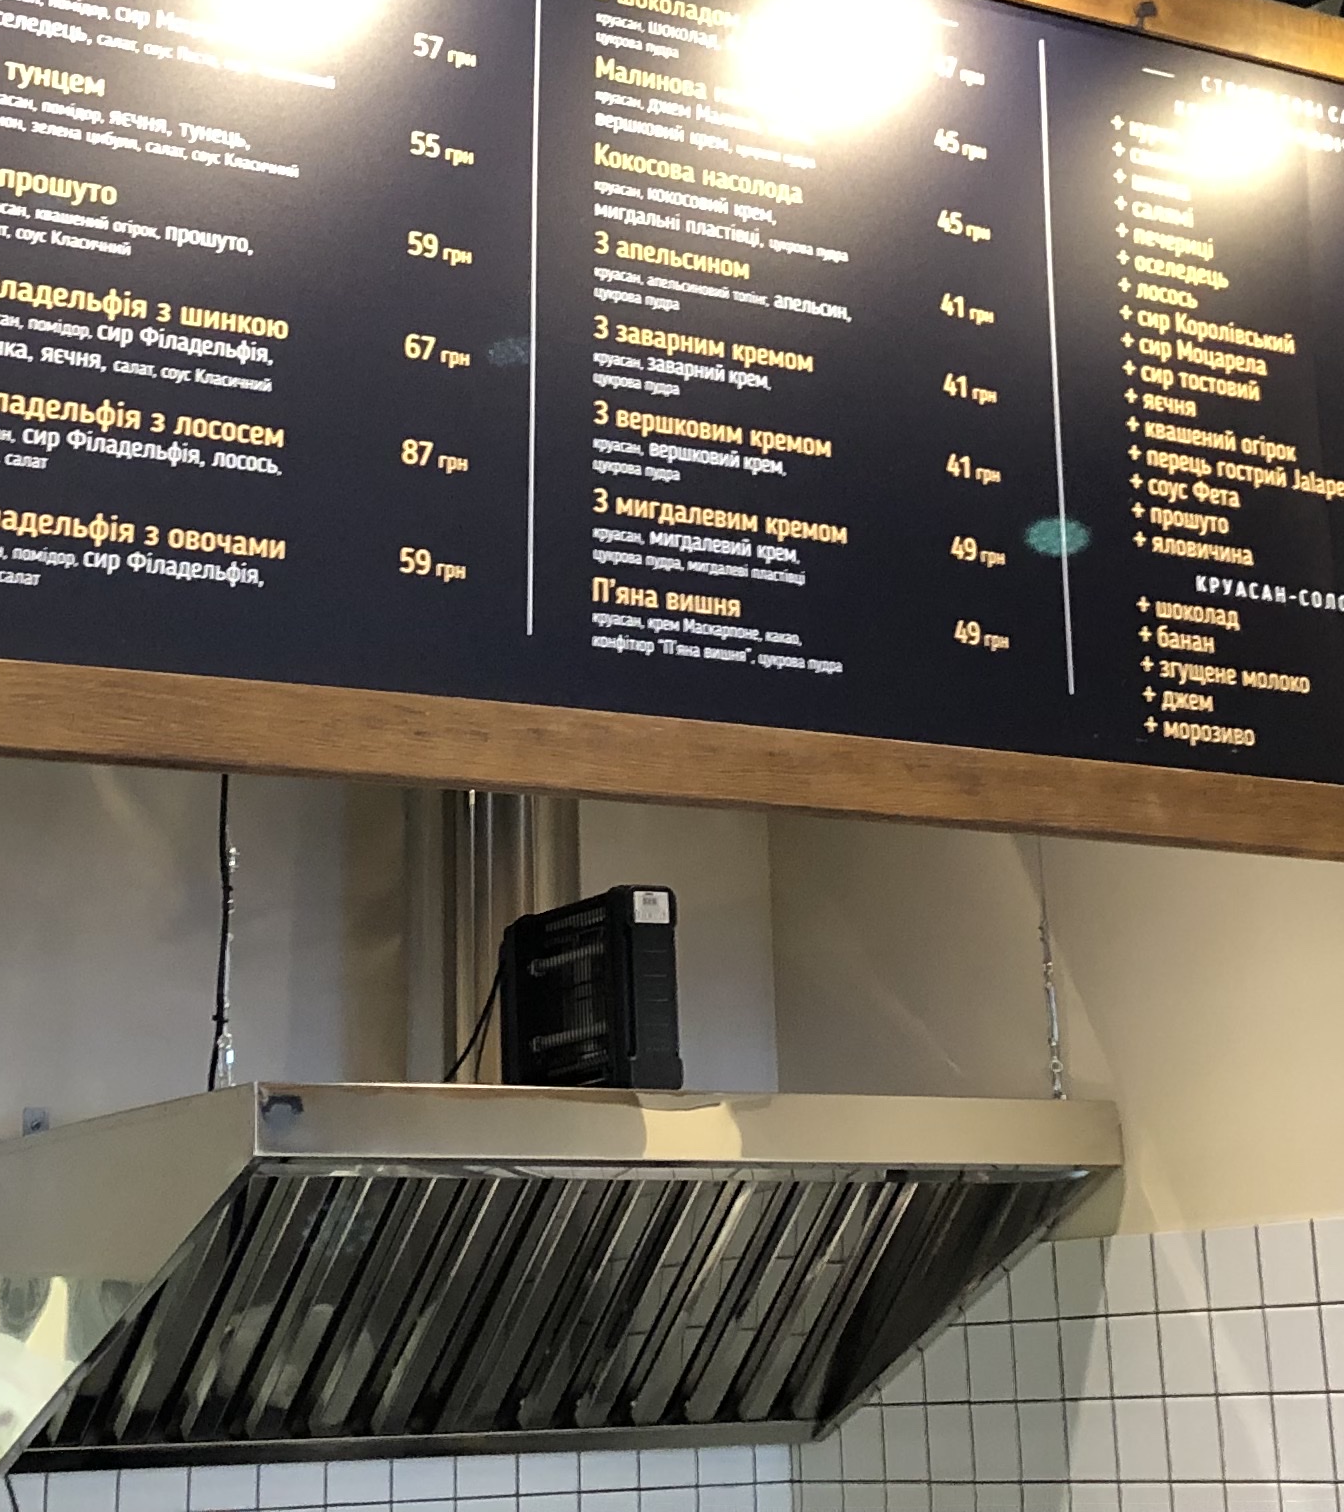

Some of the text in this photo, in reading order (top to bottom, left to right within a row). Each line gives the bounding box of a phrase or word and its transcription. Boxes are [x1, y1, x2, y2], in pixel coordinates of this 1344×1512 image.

[412, 31, 444, 59] 57
[3, 60, 105, 97] тунцем
[594, 54, 707, 100] Малинова
[409, 129, 440, 158] 55
[593, 141, 803, 206] Кокосова насолода
[164, 225, 253, 256] прошуто,
[406, 230, 472, 266] 59 грн
[593, 229, 750, 280] З апельсином
[155, 302, 171, 322] з
[179, 305, 288, 339] шинкою
[939, 292, 964, 318] 41
[96, 324, 273, 366] сир Філадельфія,
[593, 314, 813, 372] З заварним кремом
[1136, 309, 1295, 355] сир Королівський
[40, 346, 107, 372] яєчня,
[404, 332, 470, 369] 67 грн
[1138, 337, 1268, 376] сир Моцарела
[942, 372, 967, 398] 41
[1140, 364, 1260, 401] сир тостовий
[1141, 392, 1197, 417] яєчня
[149, 412, 165, 432] з
[173, 415, 284, 448] лососем
[593, 399, 832, 458] З вершковим кремом
[1144, 420, 1297, 463] квашений огірок
[21, 427, 60, 452] сир
[65, 428, 205, 467] Філадельфія,
[401, 438, 468, 474] 87 грн
[945, 452, 970, 478] 41
[1145, 449, 1287, 489] перець гострий
[1147, 477, 1240, 508] соус Фета
[592, 487, 847, 544] З мигдалевим кремом
[1149, 506, 1229, 536] прошуто
[143, 524, 159, 546] з
[167, 527, 285, 559] овочами
[950, 535, 1005, 568] 49 грн
[1151, 535, 1254, 566] яловичина
[399, 546, 466, 582] 59 грн
[665, 591, 740, 617] вишня
[1155, 600, 1240, 631] шоколад
[954, 619, 1009, 651] 49 грн
[1156, 624, 1215, 653] банан
[1158, 659, 1310, 694] згущене молоко
[1160, 690, 1213, 712] джем
[1162, 720, 1255, 746] морозиво
